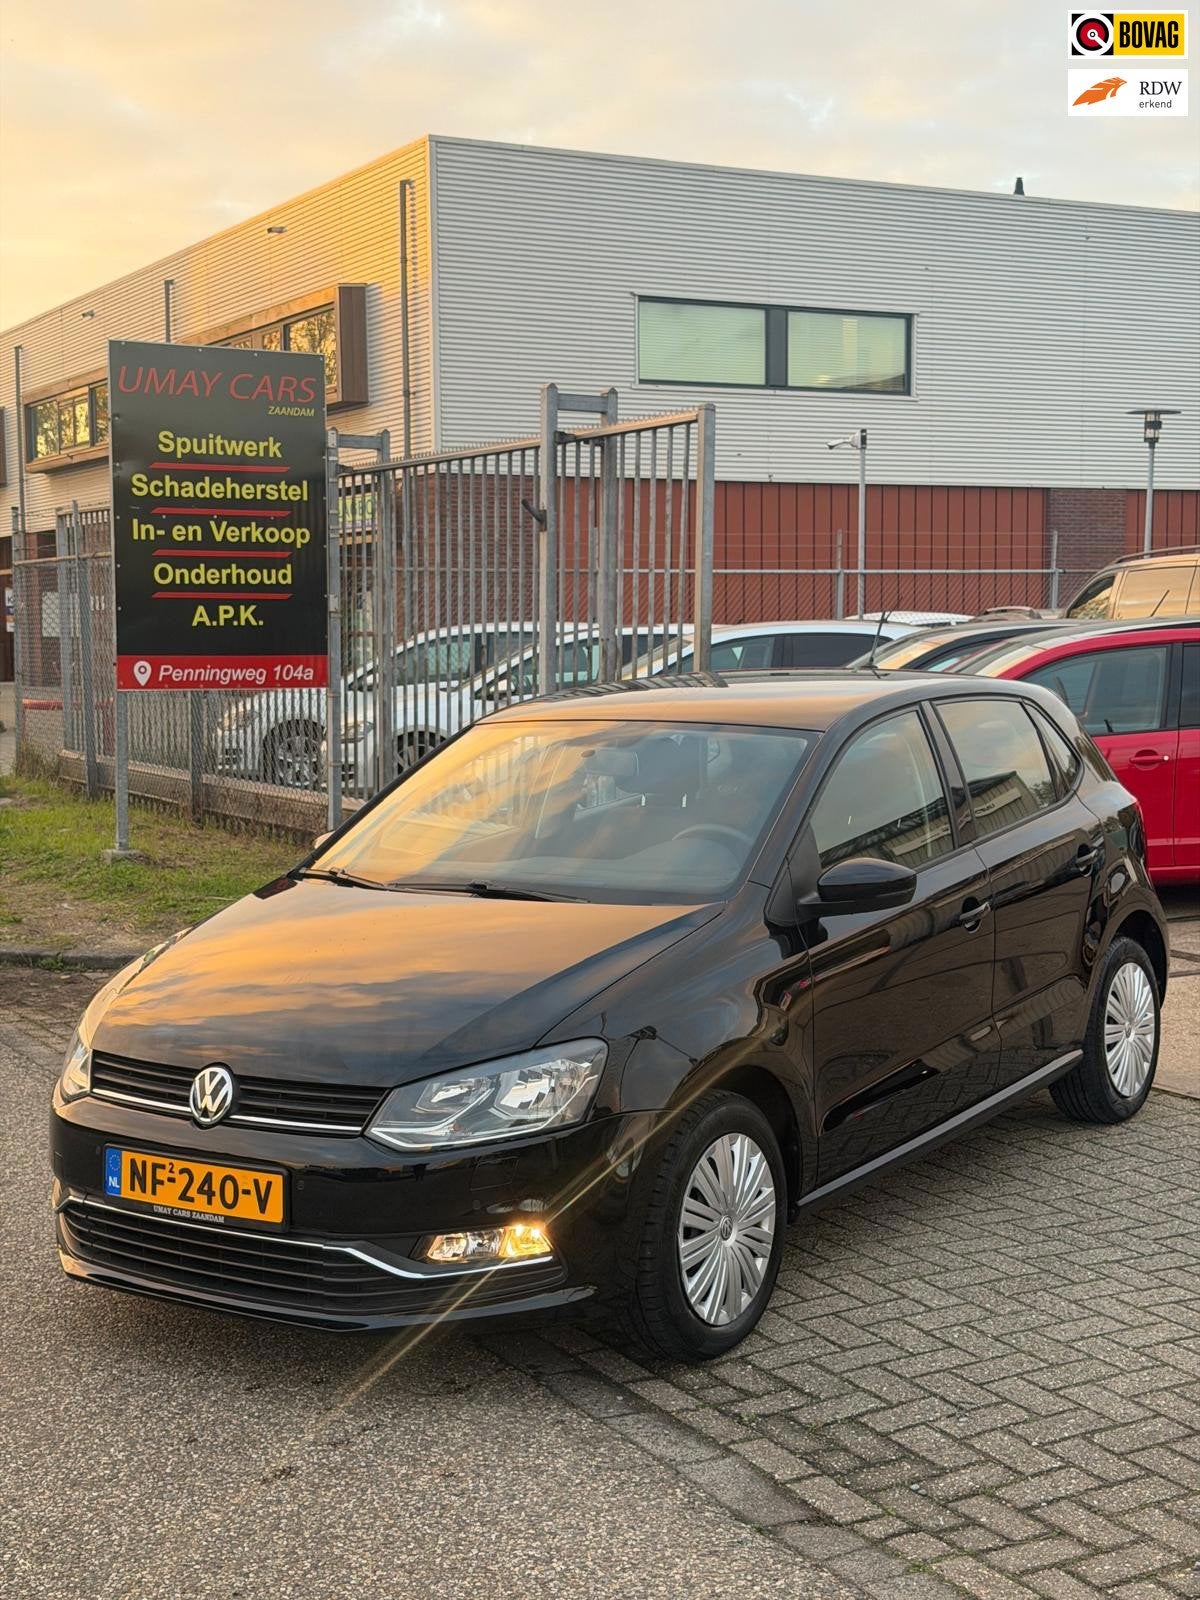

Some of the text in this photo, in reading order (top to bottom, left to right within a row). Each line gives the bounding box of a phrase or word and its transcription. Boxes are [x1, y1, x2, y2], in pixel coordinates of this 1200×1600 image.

[117, 365, 317, 404] UMAY CARS
[267, 405, 315, 417] ZAANDAM
[158, 430, 283, 459] Spuitwerk
[131, 473, 308, 501] Schadeherstel
[132, 518, 311, 549] In- en Verkoop
[153, 562, 293, 585] Onderhoud
[191, 604, 264, 627] A.P.K.
[158, 664, 315, 684] Penningweg 104a
[108, 1175, 120, 1189] NL
[153, 1204, 225, 1223] UMAY CARS ZAANDAM
